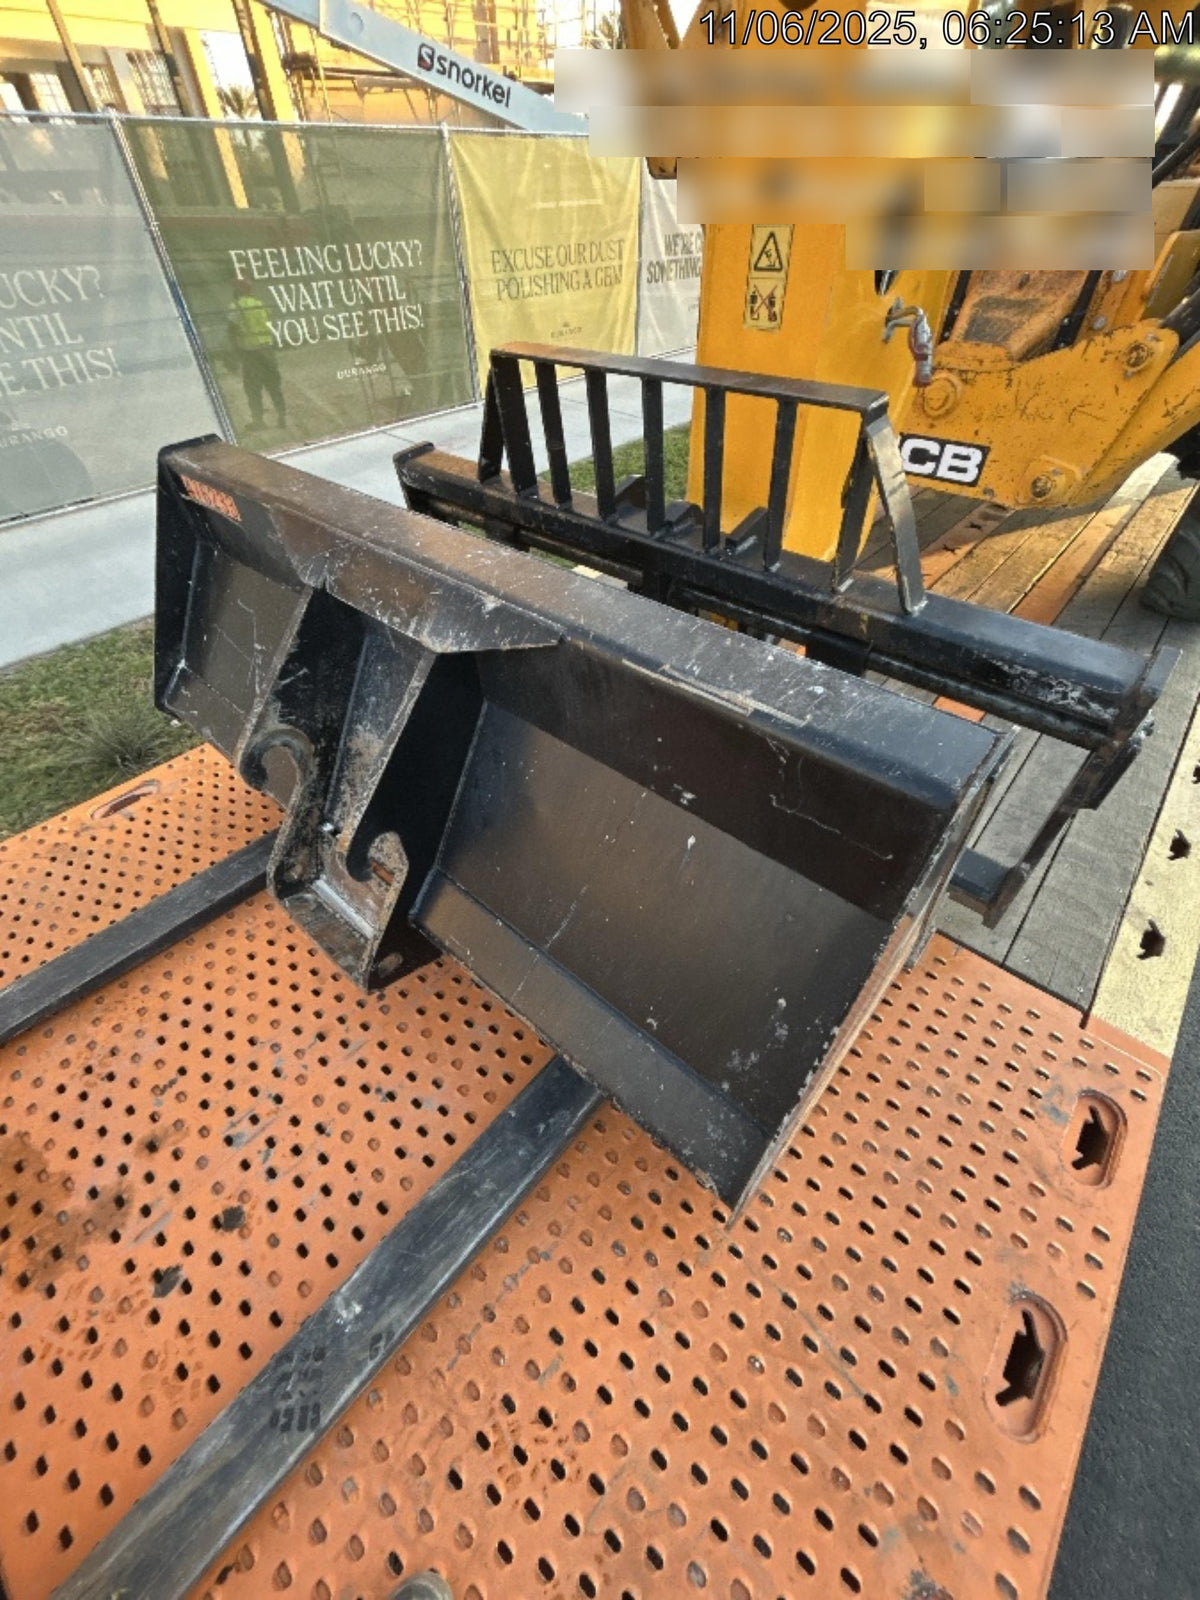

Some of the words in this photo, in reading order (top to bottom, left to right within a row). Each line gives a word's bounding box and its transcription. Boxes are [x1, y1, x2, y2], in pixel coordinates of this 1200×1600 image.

[436, 55, 511, 108] snorkel
[229, 244, 343, 280] FEELING
[344, 239, 423, 272] LUCKY?
[490, 245, 556, 275] EXCUSE
[556, 243, 588, 269] OUR
[589, 238, 626, 264] DUST
[268, 280, 335, 314] WAIT
[338, 275, 406, 306] UNTIL
[495, 264, 582, 301] POLISHING
[583, 272, 593, 290] A
[266, 316, 320, 348] YOU
[322, 310, 369, 341] SEE
[368, 303, 425, 335] THIS!
[21, 347, 123, 389] THIS!
[900, 438, 983, 483] CB
